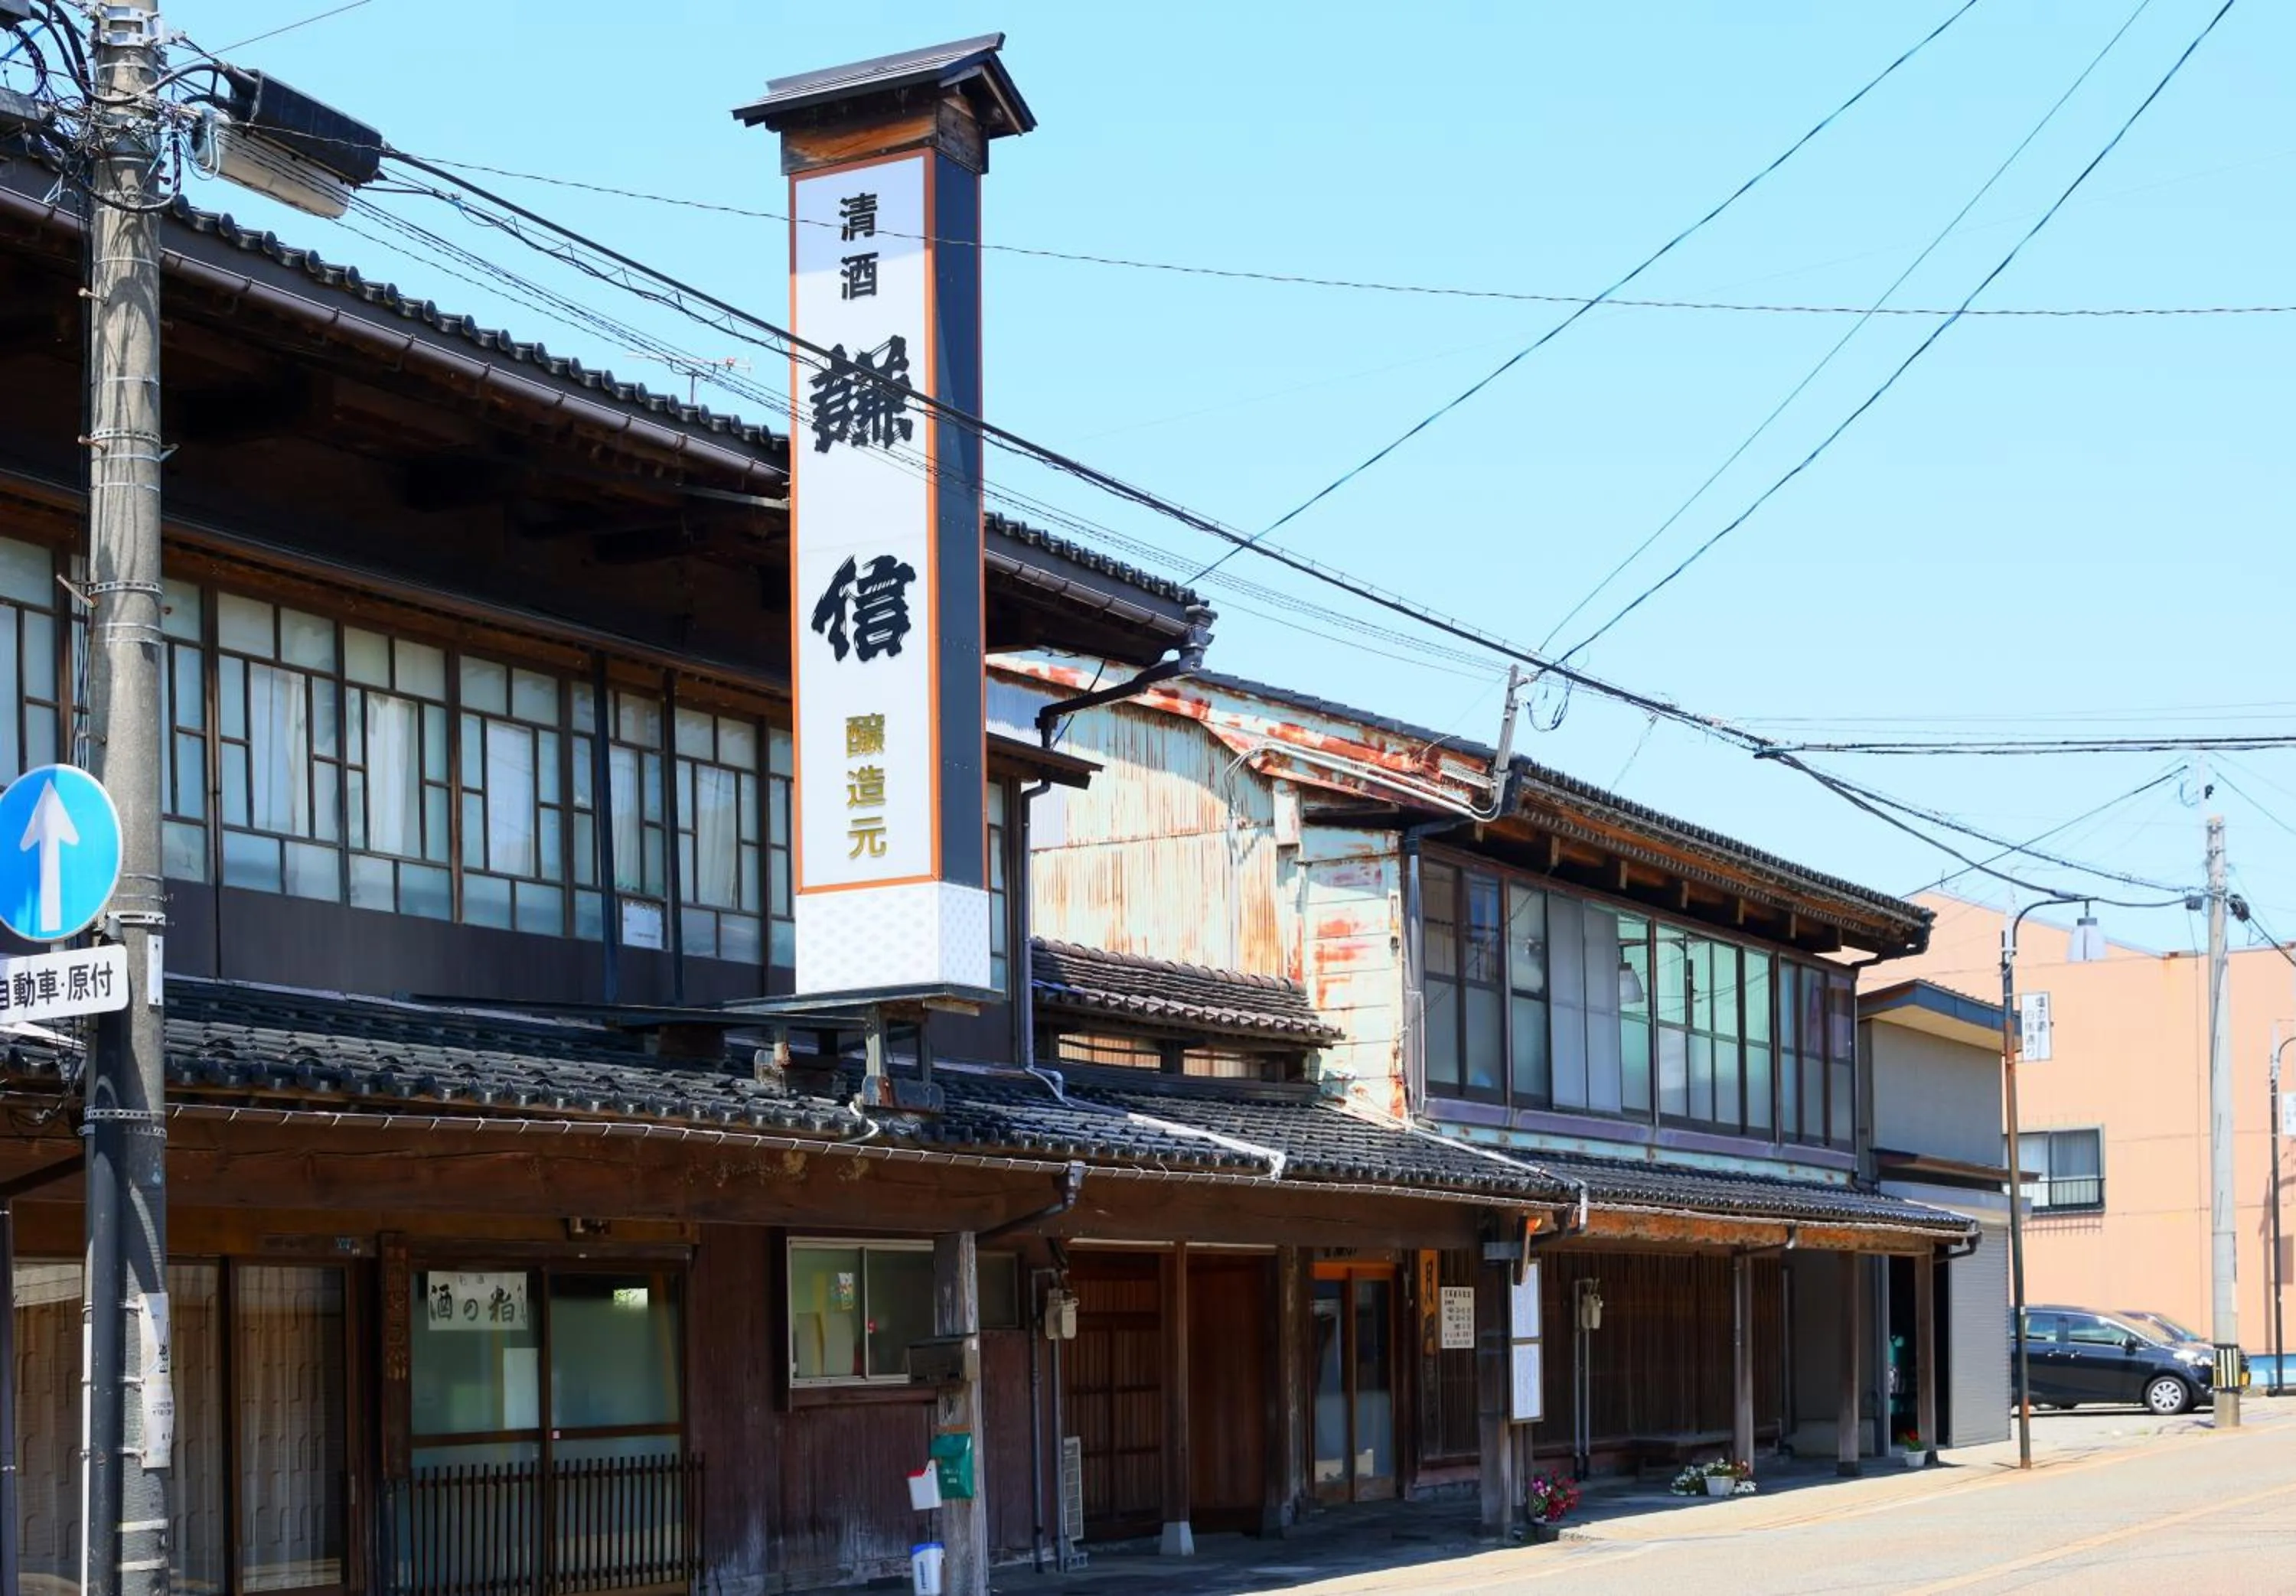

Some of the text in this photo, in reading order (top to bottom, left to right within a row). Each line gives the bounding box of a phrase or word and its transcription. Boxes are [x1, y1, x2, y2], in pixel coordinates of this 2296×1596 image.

[839, 192, 879, 300] 清酒
[846, 713, 887, 859] 醸造元
